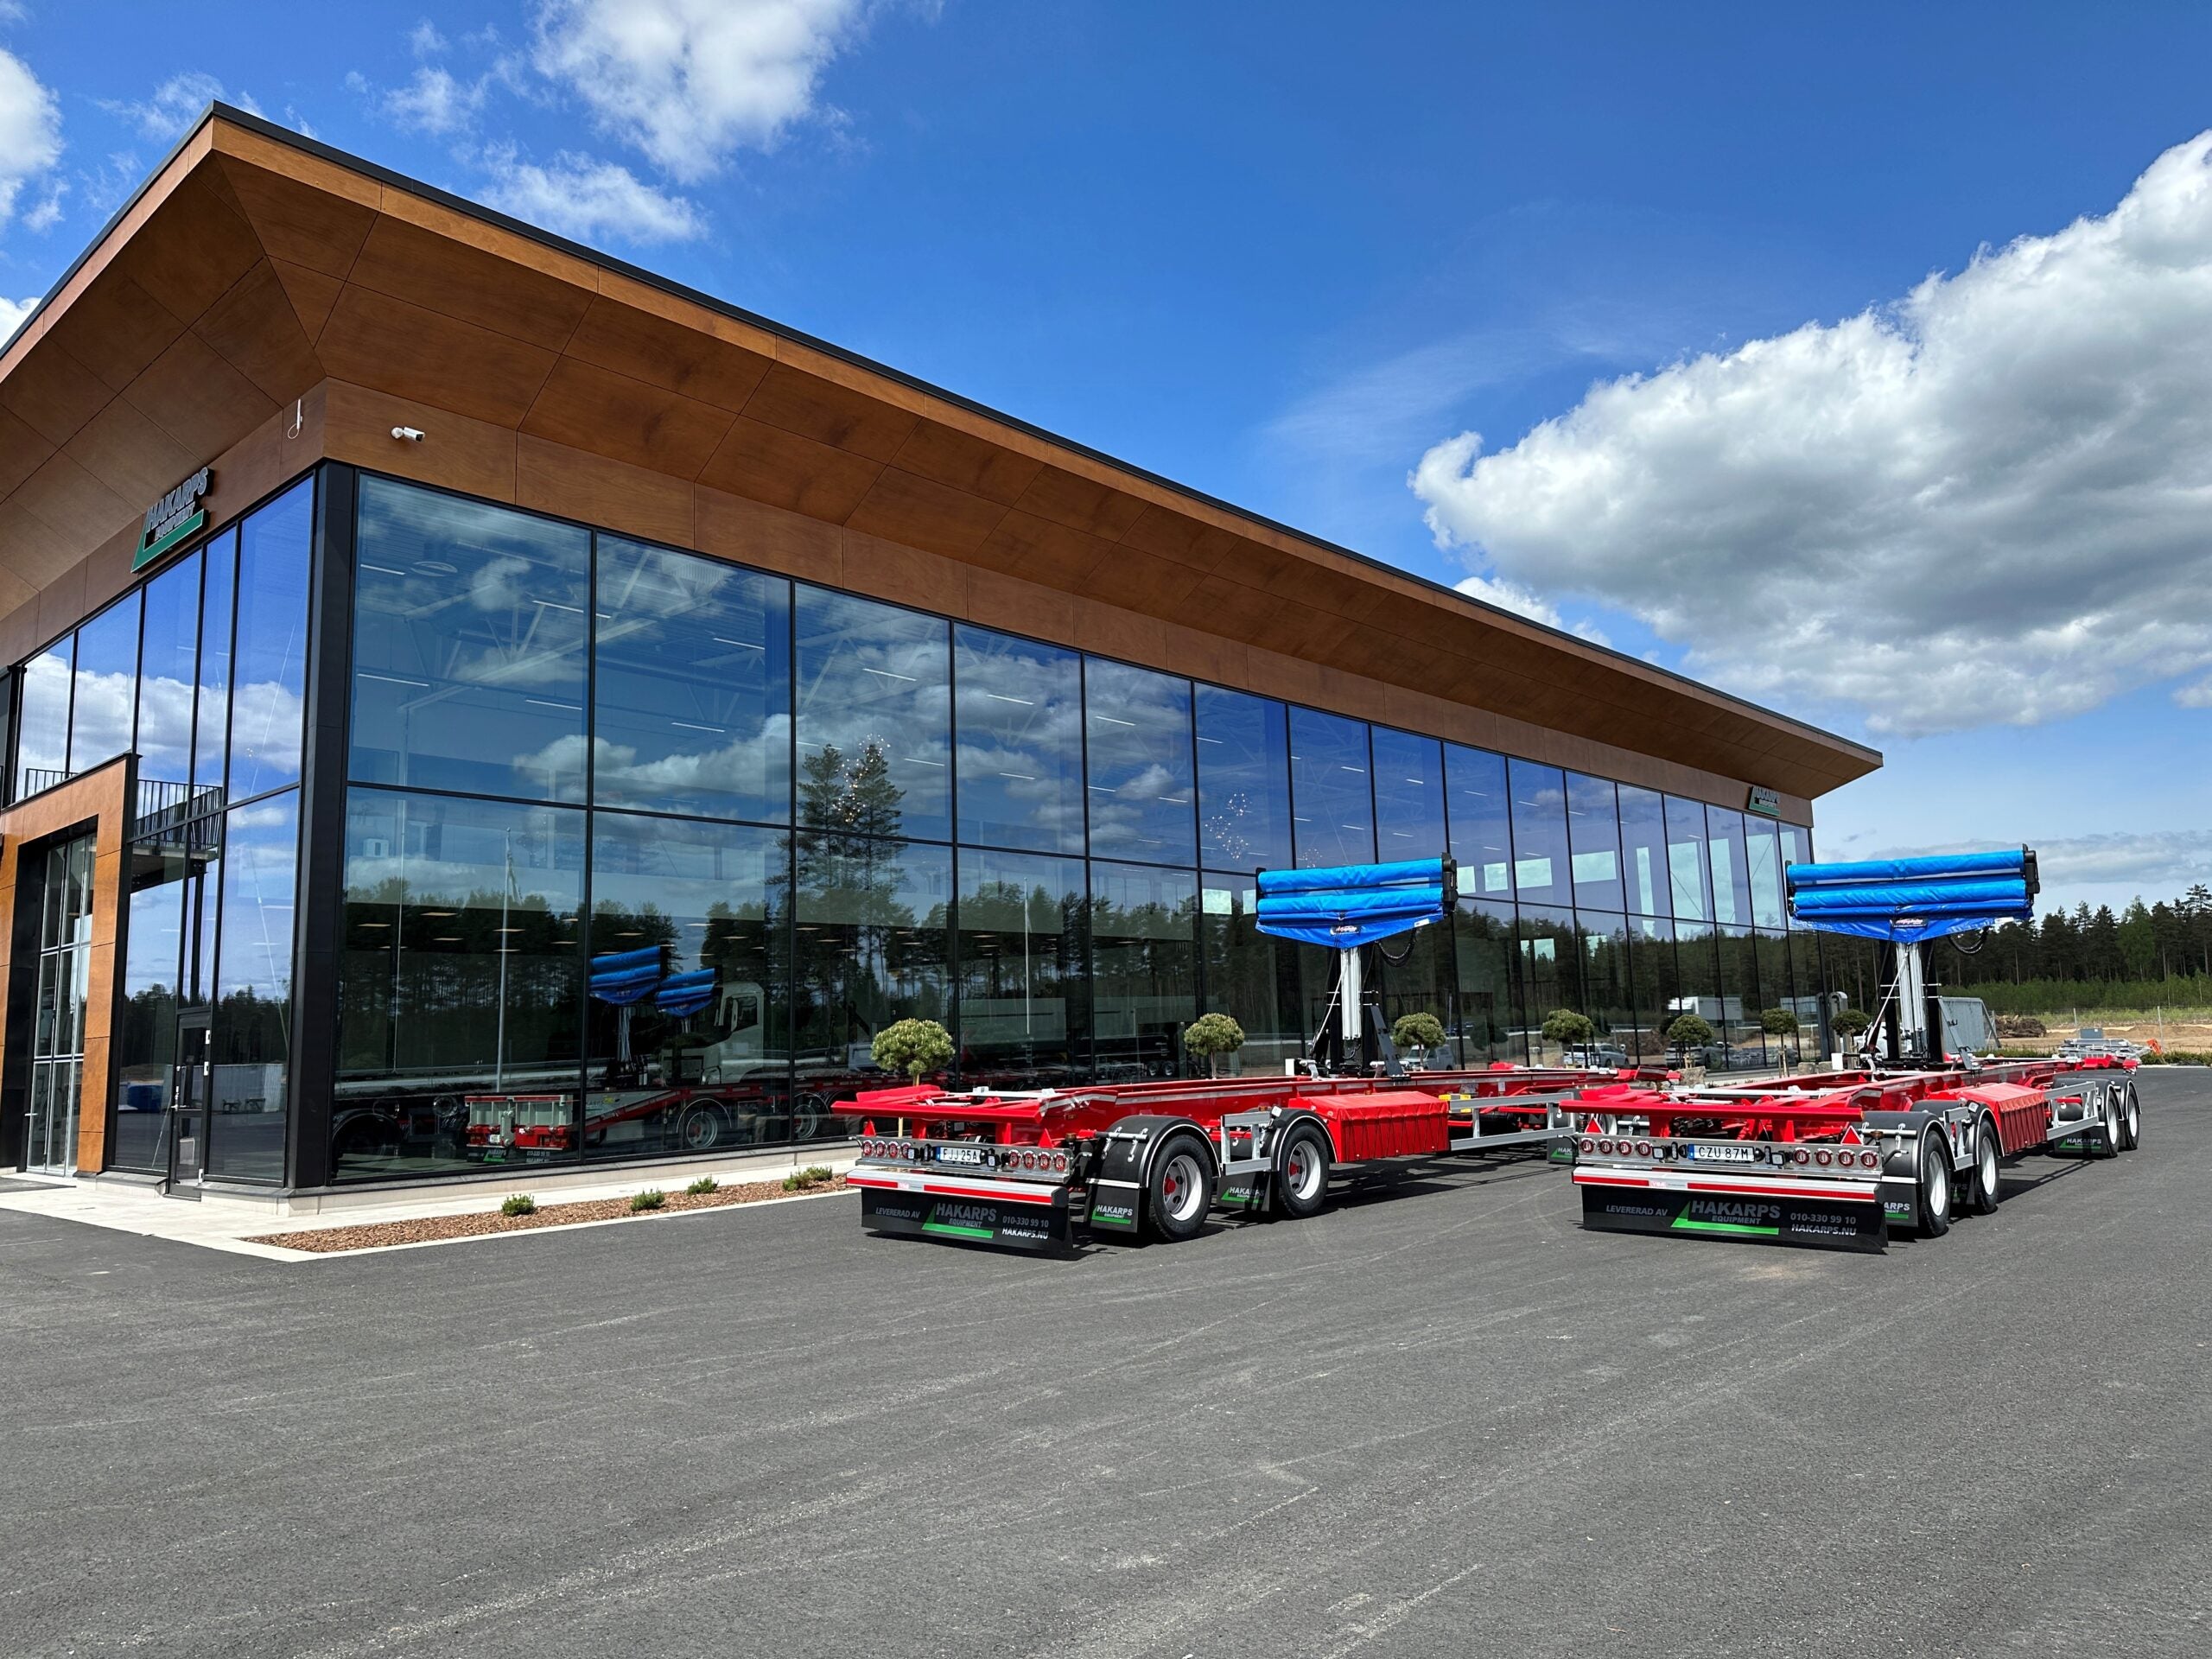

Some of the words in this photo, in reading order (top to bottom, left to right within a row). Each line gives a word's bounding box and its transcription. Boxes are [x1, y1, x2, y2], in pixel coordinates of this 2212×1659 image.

[147, 467, 208, 532] HAKARPS
[154, 501, 195, 543] EQUIPMENT
[944, 1148, 959, 1160] FJJ
[961, 1150, 977, 1161] 25A
[1699, 1147, 1721, 1158] CZU
[1726, 1147, 1748, 1160] 87M
[875, 1206, 910, 1217] LEVERERAD
[911, 1210, 921, 1218] AV
[936, 1202, 997, 1222] HAKARPS
[1096, 1205, 1133, 1217] HAKARPS
[1605, 1205, 1654, 1216] LEVERERAD
[1655, 1208, 1669, 1217] AV
[1691, 1200, 1781, 1218] HAKARPS
[1884, 1201, 1910, 1211] ARPS
[949, 1217, 982, 1228] EQUIPMENT
[1002, 1215, 1029, 1226] 010-330
[1030, 1217, 1039, 1227] 99
[1040, 1219, 1049, 1228] 10
[1712, 1215, 1762, 1224] EQUIPMENT
[1789, 1212, 1827, 1223] 010-330
[1830, 1215, 1842, 1224] 99
[1845, 1216, 1857, 1224] 10
[1002, 1227, 1048, 1240] HAKARPS.NU
[1791, 1224, 1857, 1236] HAKARPS.NU
